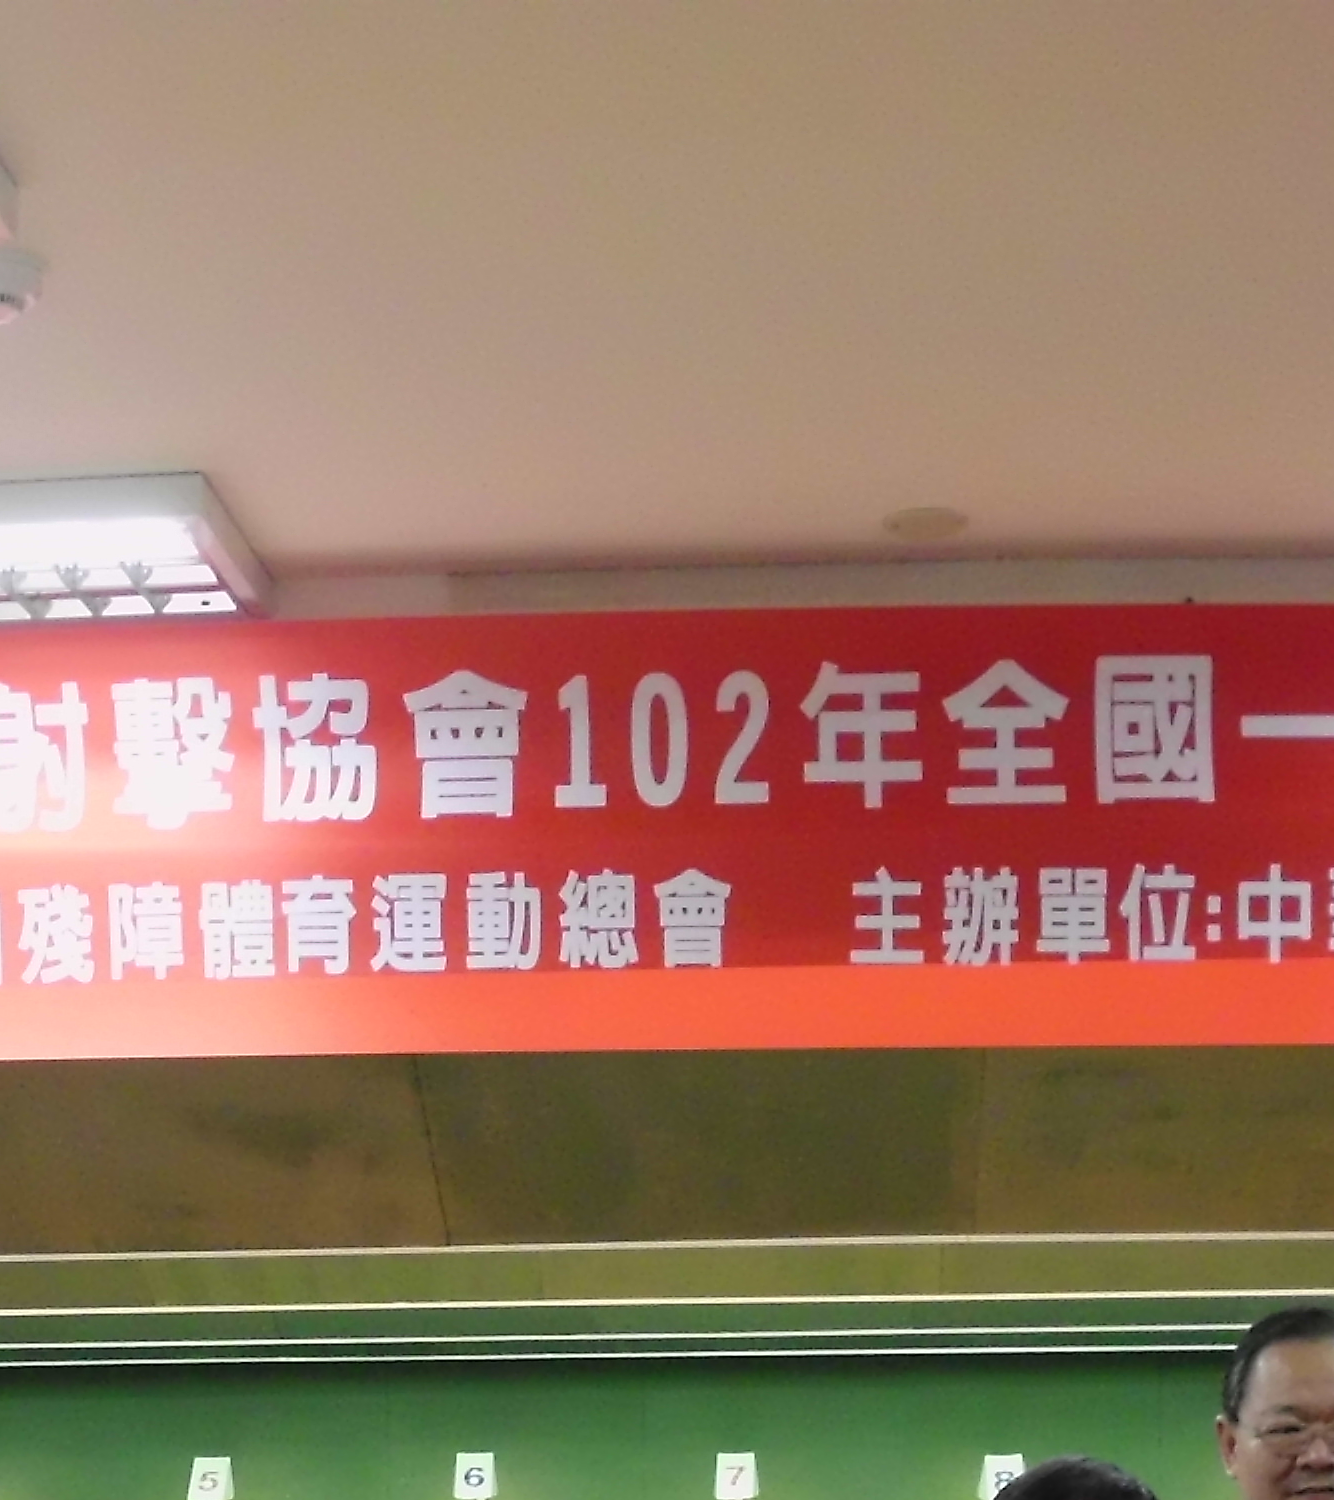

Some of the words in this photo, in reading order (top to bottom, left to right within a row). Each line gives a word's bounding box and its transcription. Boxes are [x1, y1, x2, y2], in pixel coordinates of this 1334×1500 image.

[198, 1470, 219, 1492] 5
[463, 1466, 485, 1488] 6
[725, 1464, 747, 1486] 7
[993, 1470, 1015, 1492] 8
